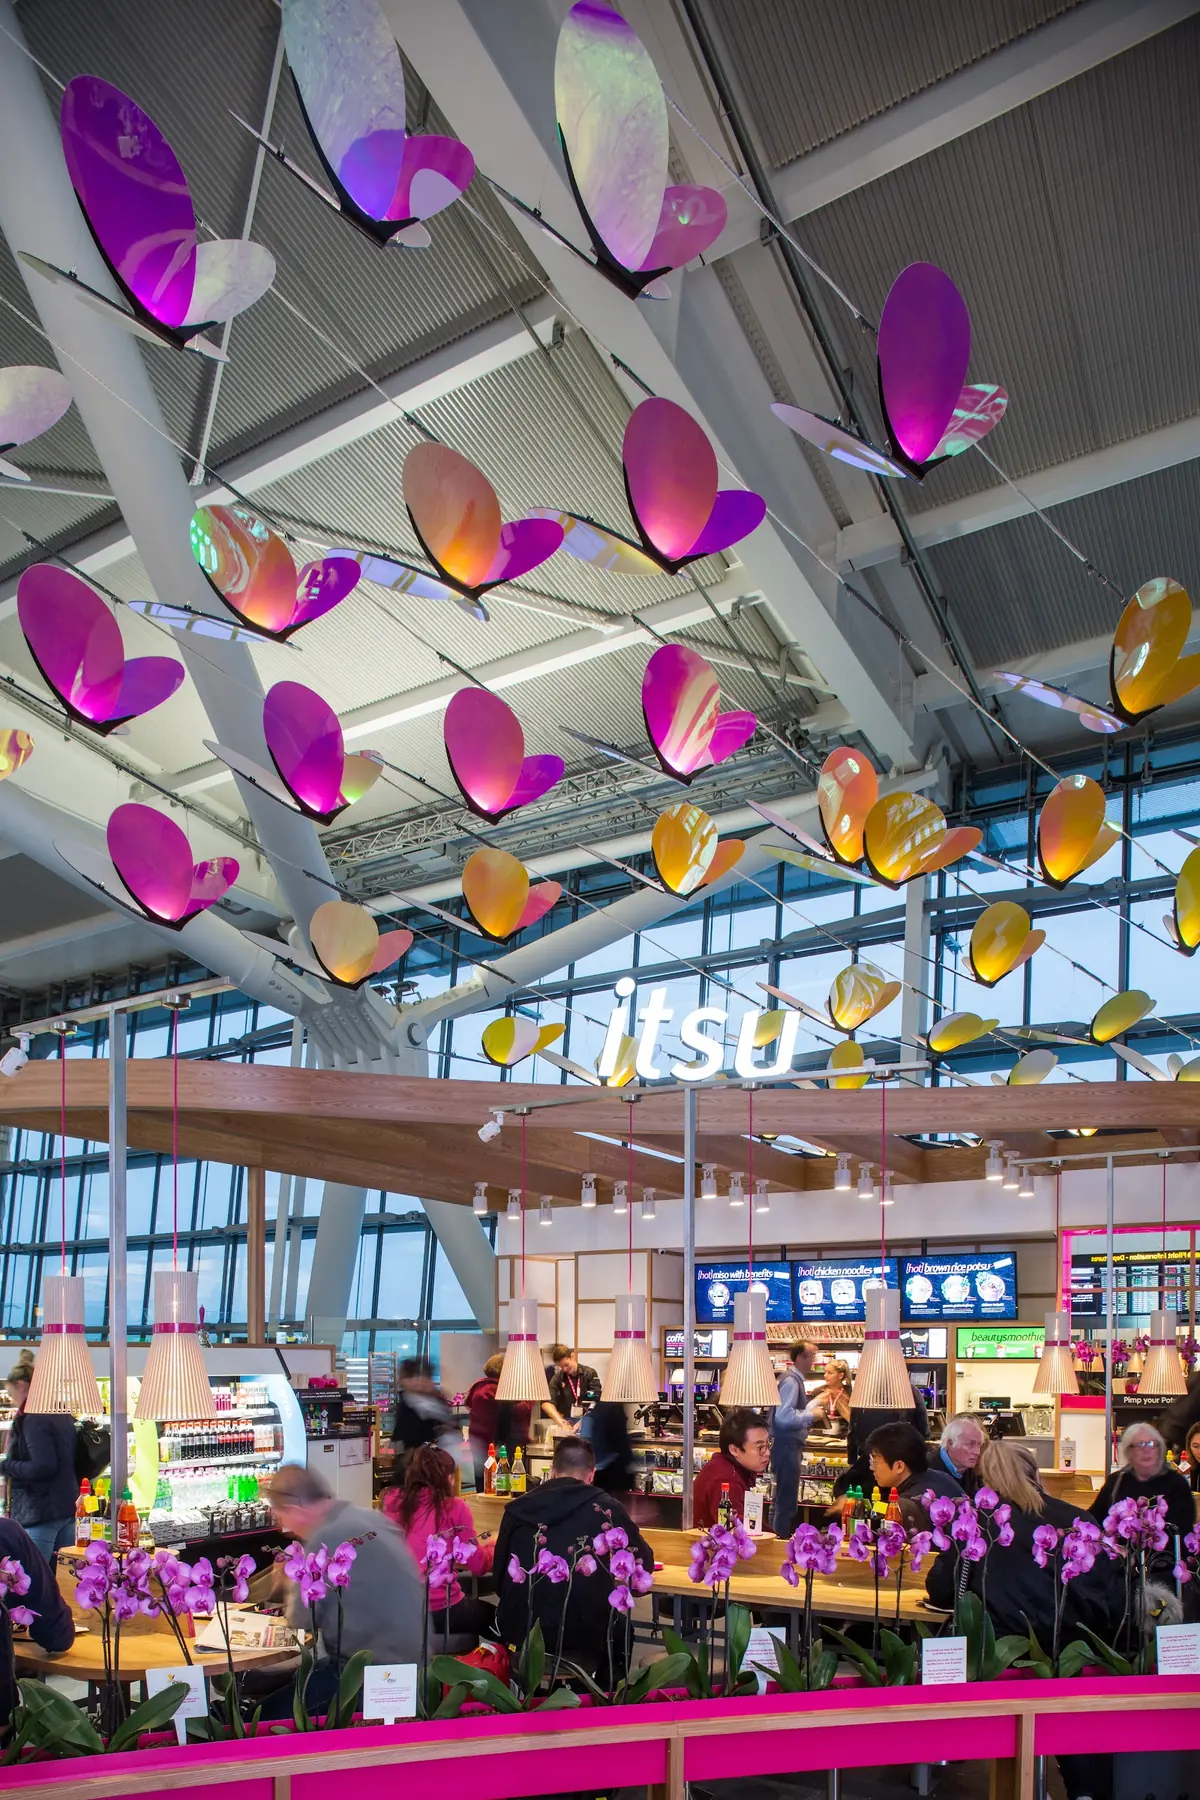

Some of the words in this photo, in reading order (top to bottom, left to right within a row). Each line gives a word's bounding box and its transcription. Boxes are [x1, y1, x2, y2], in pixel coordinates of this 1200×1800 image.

[597, 977, 801, 1083] itsu
[814, 1266, 841, 1276] chicken
[842, 1265, 873, 1275] noodles
[924, 1262, 950, 1272] brown
[951, 1262, 966, 1272] rice
[666, 1332, 684, 1342] coffe
[1123, 1396, 1142, 1405] Pimp
[1143, 1397, 1160, 1405] your
